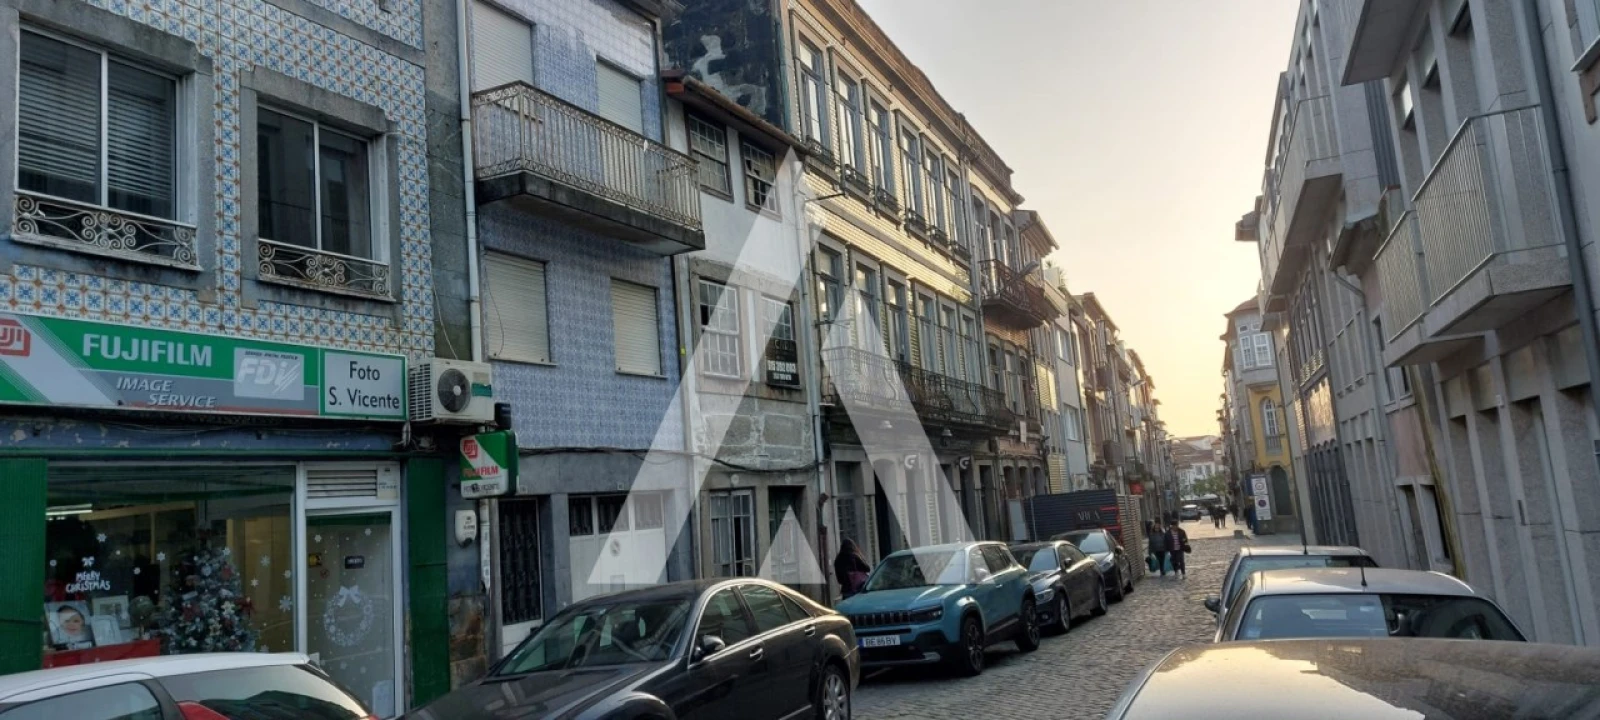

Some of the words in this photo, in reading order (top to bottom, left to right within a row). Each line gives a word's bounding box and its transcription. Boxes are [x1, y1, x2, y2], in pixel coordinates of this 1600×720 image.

[82, 333, 212, 368] FUJIFILM
[349, 360, 381, 381] Foto
[116, 377, 173, 392] IMAGE
[147, 393, 216, 408] SERVICE
[329, 386, 342, 406] S.
[346, 387, 400, 410] Vicente
[75, 570, 101, 581] MERRY
[65, 580, 111, 593] CHRISTMAS
